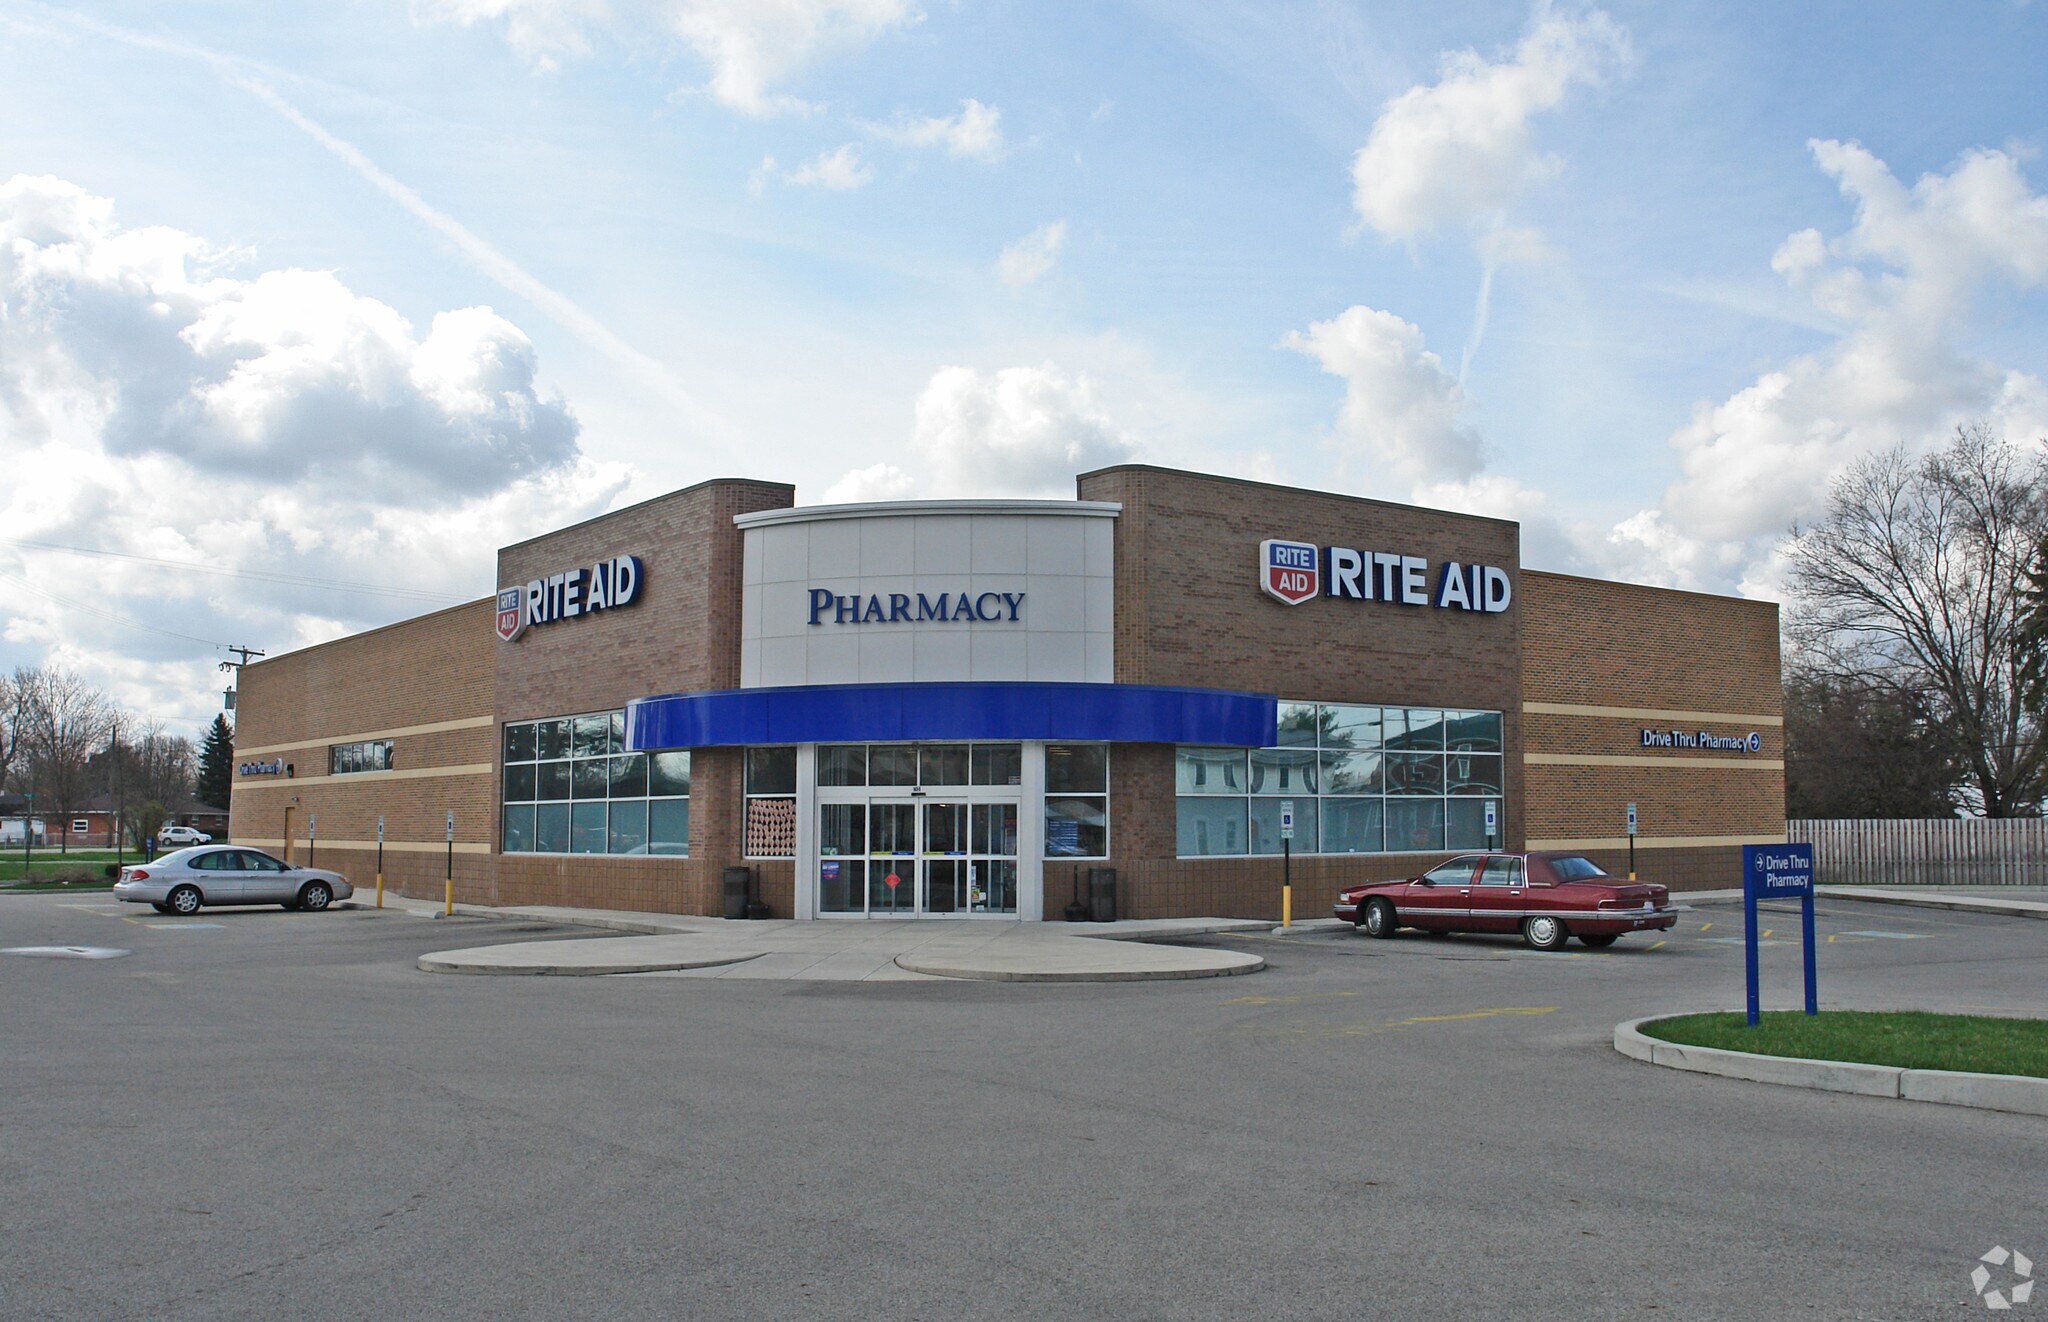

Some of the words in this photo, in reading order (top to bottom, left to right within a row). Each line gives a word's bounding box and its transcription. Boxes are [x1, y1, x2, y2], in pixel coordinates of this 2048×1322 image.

[1276, 547, 1310, 567] RITE
[1278, 571, 1308, 592] AID
[1330, 546, 1429, 605] RITE
[1440, 562, 1512, 612] AID
[501, 592, 517, 609] RITE
[526, 569, 582, 626] RITE
[586, 555, 638, 612] AID
[807, 588, 1026, 625] PHARMACY
[501, 613, 515, 630] AID
[1643, 729, 1671, 746] Drive
[1672, 730, 1697, 747] Thru
[1700, 732, 1748, 752] Pharmacy
[1766, 855, 1789, 870] Drive
[1789, 854, 1809, 869] Thru
[1766, 873, 1809, 889] Pharmacy
